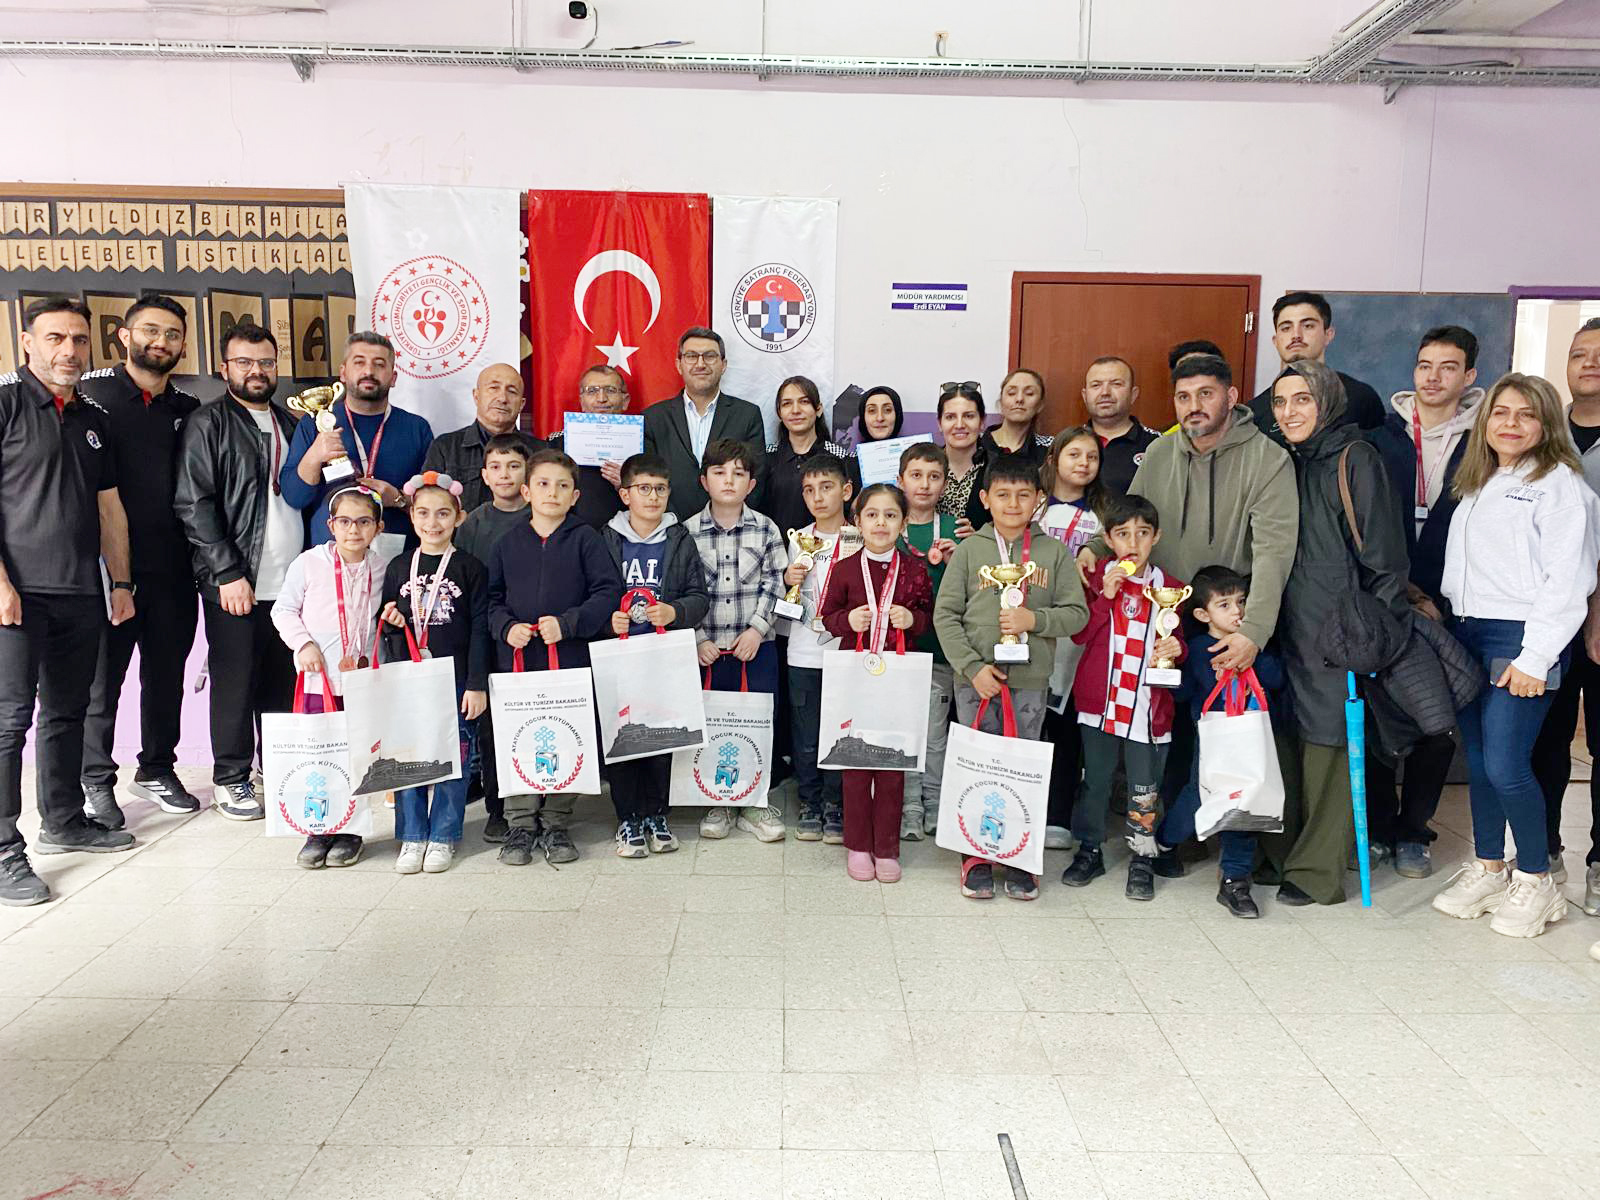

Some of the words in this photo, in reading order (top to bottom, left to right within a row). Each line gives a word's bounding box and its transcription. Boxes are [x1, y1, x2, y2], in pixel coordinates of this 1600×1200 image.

[63, 208, 185, 225] YILDIZ
[201, 209, 256, 227] BİR
[16, 245, 157, 262] LELEBET
[185, 244, 347, 264] İSTİKLAL
[420, 278, 451, 290] GENÇLİK
[450, 288, 461, 298] VE
[394, 281, 419, 328] CUMHURİYETİ
[734, 285, 747, 323] TÜRKİYE
[744, 267, 781, 286] SATRANÇ
[783, 268, 814, 325] FEDERASYONU
[897, 292, 923, 300] MÜDÜR
[924, 293, 964, 301] YARDIMCISI
[457, 299, 468, 320] SPOR
[928, 303, 946, 311] EYAN
[438, 322, 466, 354] BAKANLIĞI
[766, 343, 783, 351] 1991
[512, 726, 525, 753] ATATÜRK
[525, 715, 547, 726] ÇOCUK
[548, 715, 584, 747] KÜTÜPHANESİ
[710, 732, 733, 741] ÇOCUK
[279, 768, 296, 797] ATATÜRK
[318, 760, 351, 786] KÜTÜPHAN
[986, 764, 1009, 773] TURİZM
[1009, 769, 1043, 780] BAKANLIĞI
[958, 786, 974, 808] ATATÜRK
[974, 780, 998, 789] ÇOCUK
[1000, 783, 1031, 823] KÜTÜPHANESİ
